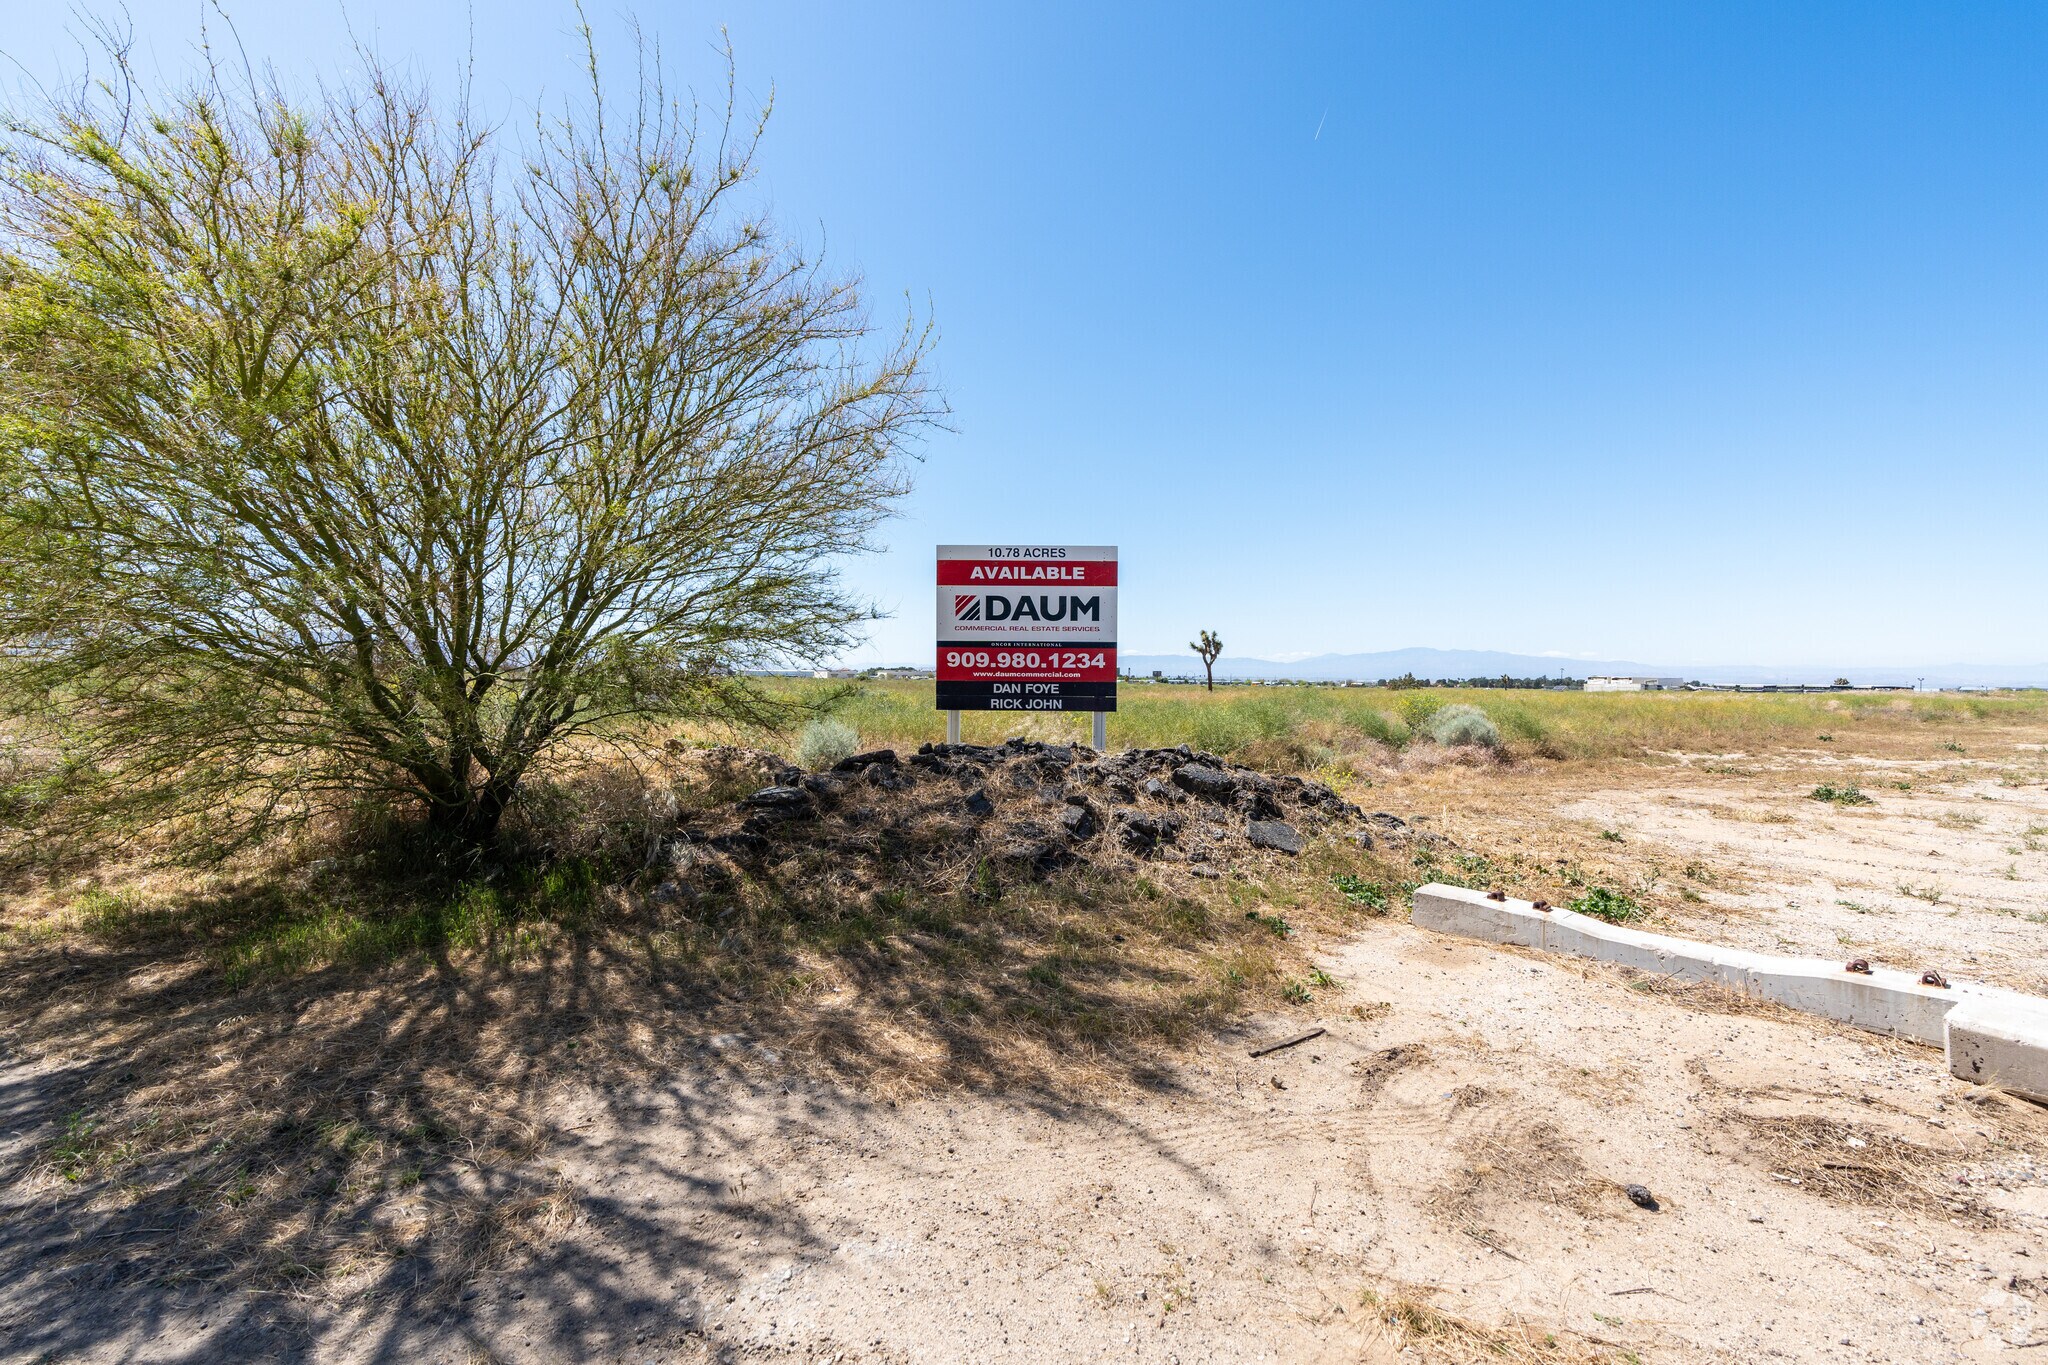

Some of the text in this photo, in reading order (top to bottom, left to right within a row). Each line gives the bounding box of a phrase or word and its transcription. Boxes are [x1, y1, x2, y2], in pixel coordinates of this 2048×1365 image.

[988, 548, 1066, 558] 10.78 ACRES
[970, 567, 1085, 580] AVAILABLE
[986, 595, 1100, 621] DAUM
[946, 652, 1106, 669] 909.980.1234
[993, 684, 1059, 694] DAN FOYE
[991, 699, 1062, 709] RICK JOHN
